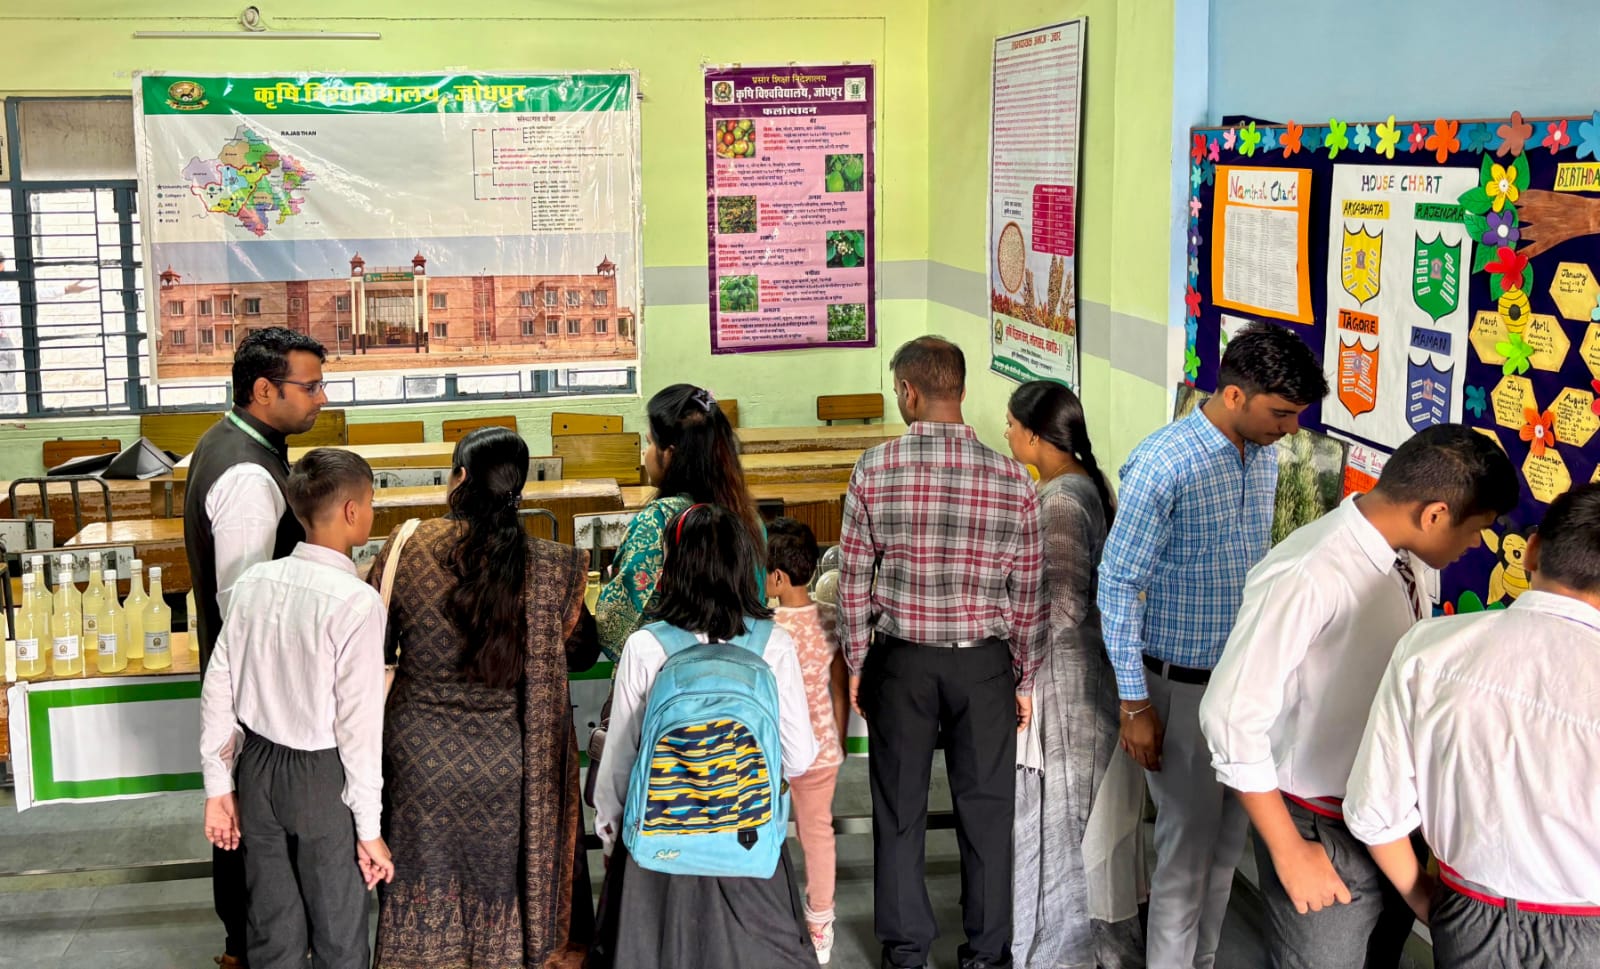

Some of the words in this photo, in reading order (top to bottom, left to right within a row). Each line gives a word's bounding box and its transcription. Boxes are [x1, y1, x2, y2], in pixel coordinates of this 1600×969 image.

[752, 75, 770, 84] प्रसार
[771, 74, 791, 84] शिक्षा
[792, 73, 827, 84] निदेशालय
[254, 82, 301, 109] कृषि
[453, 80, 526, 108] जोधपुर
[736, 87, 754, 101] कृषि
[755, 85, 812, 100] विश्वविद्यालय,
[814, 84, 842, 101] जोधपुर
[762, 107, 817, 116] फलोत्पादन
[1271, 180, 1297, 201] Chart
[1361, 175, 1395, 192] HOUSE
[1400, 175, 1442, 194] CHART
[1343, 202, 1384, 217] ARYABHATA
[1415, 204, 1465, 222] RAJENDRA
[1340, 311, 1377, 334] TAGORE
[1480, 316, 1498, 327] March
[1413, 328, 1447, 351] RAMAN
[1507, 380, 1524, 399] July
[1564, 392, 1588, 409] August
